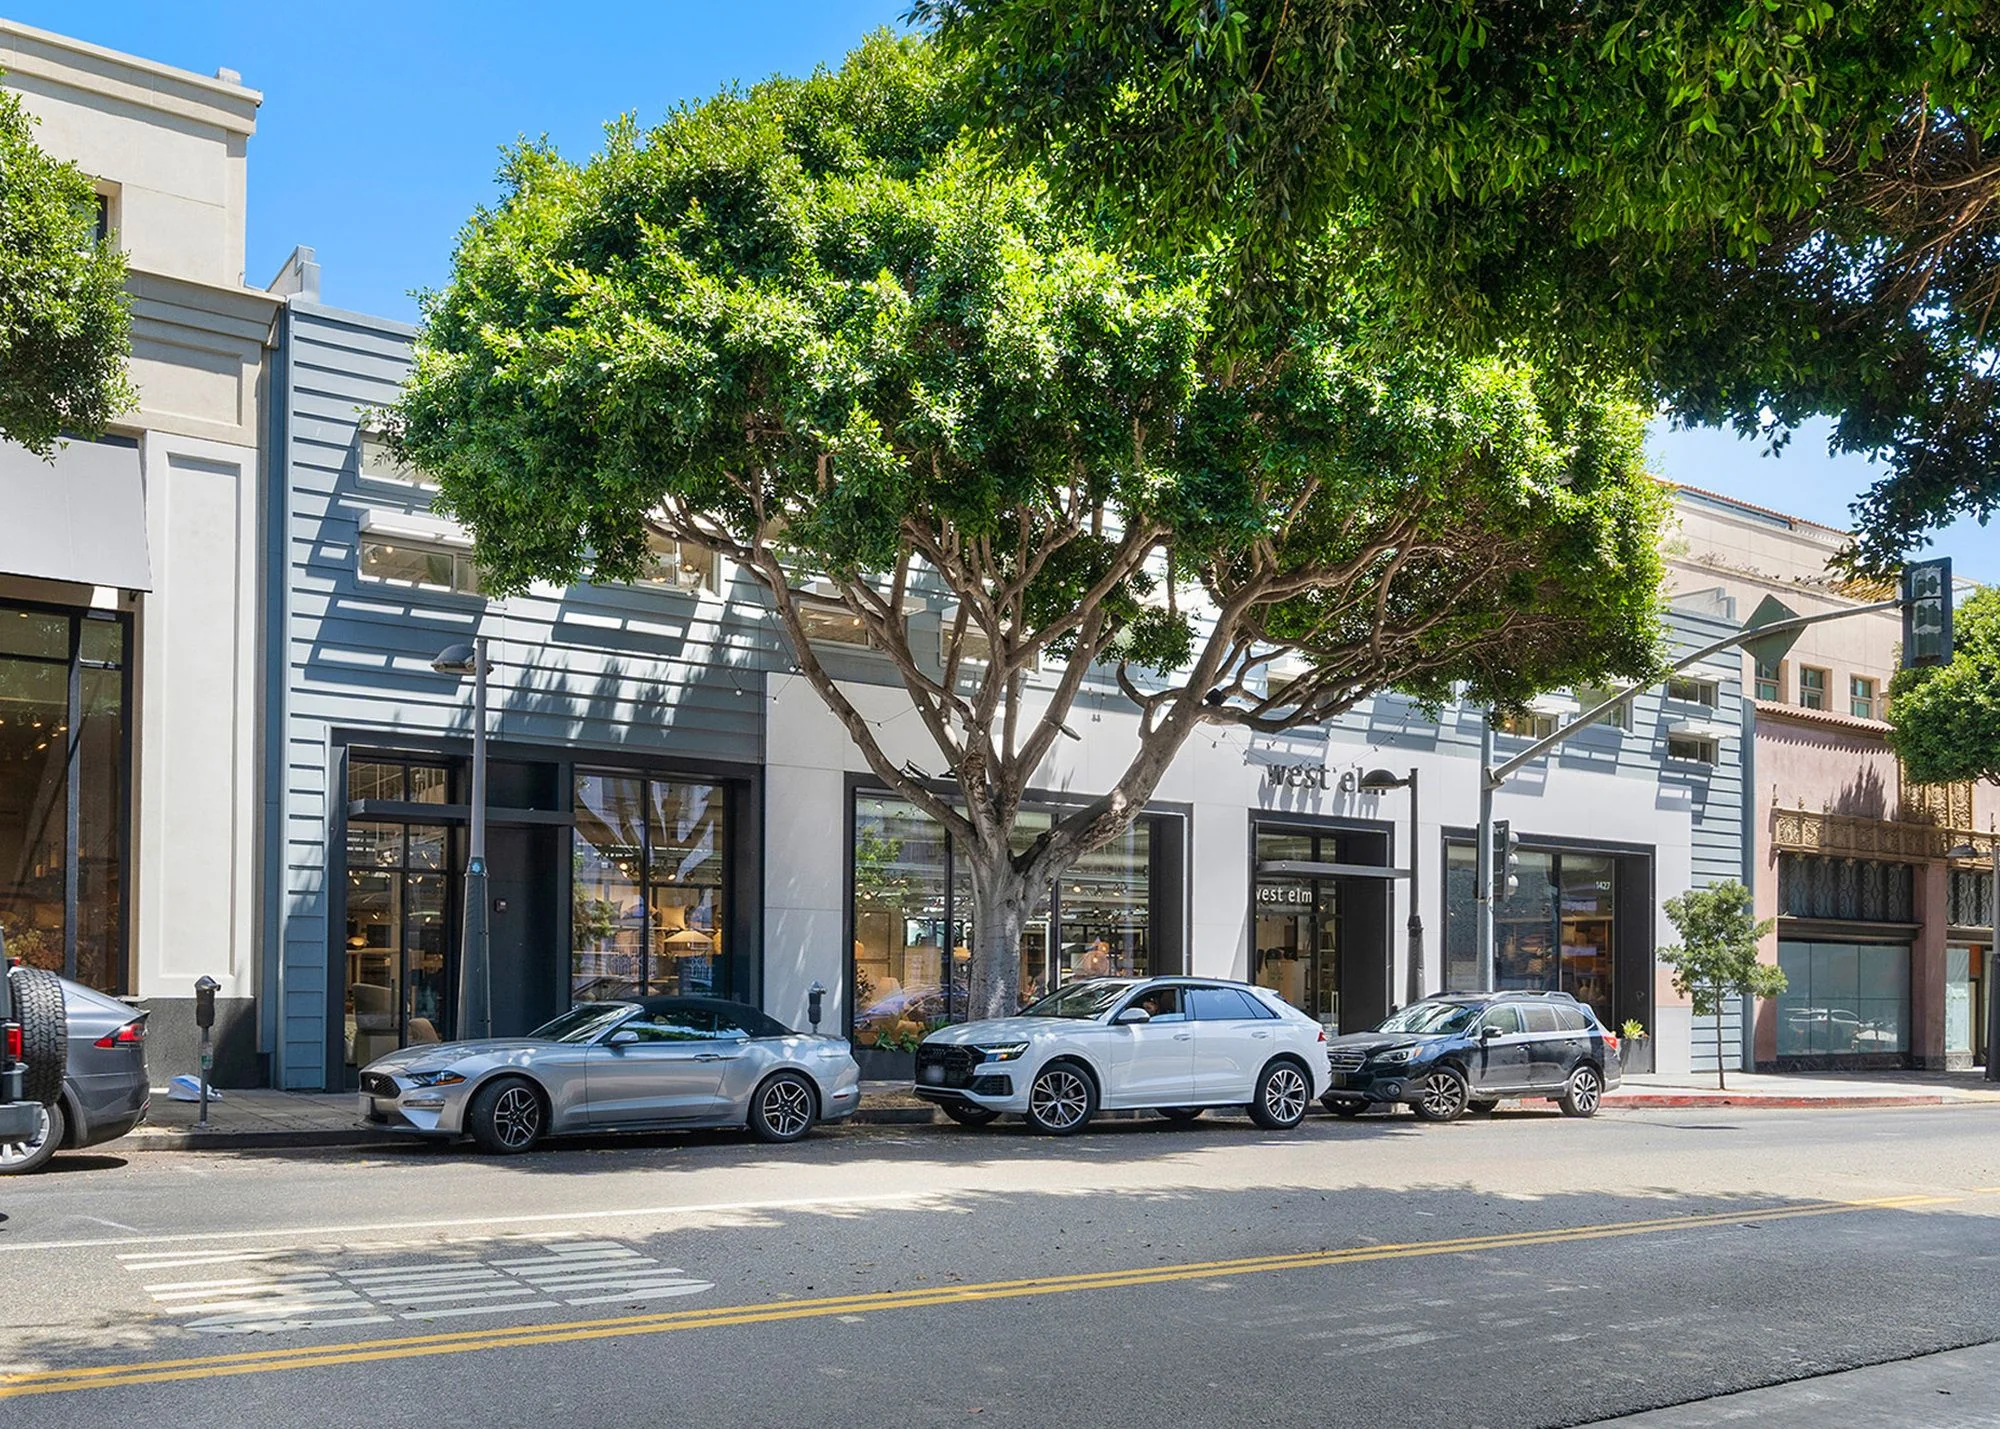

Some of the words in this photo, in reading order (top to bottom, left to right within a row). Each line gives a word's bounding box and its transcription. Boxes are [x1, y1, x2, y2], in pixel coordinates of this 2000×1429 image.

[1267, 763, 1330, 790] west
[1341, 767, 1386, 796] el
[1595, 881, 1610, 890] 1427
[1288, 887, 1312, 903] elm
